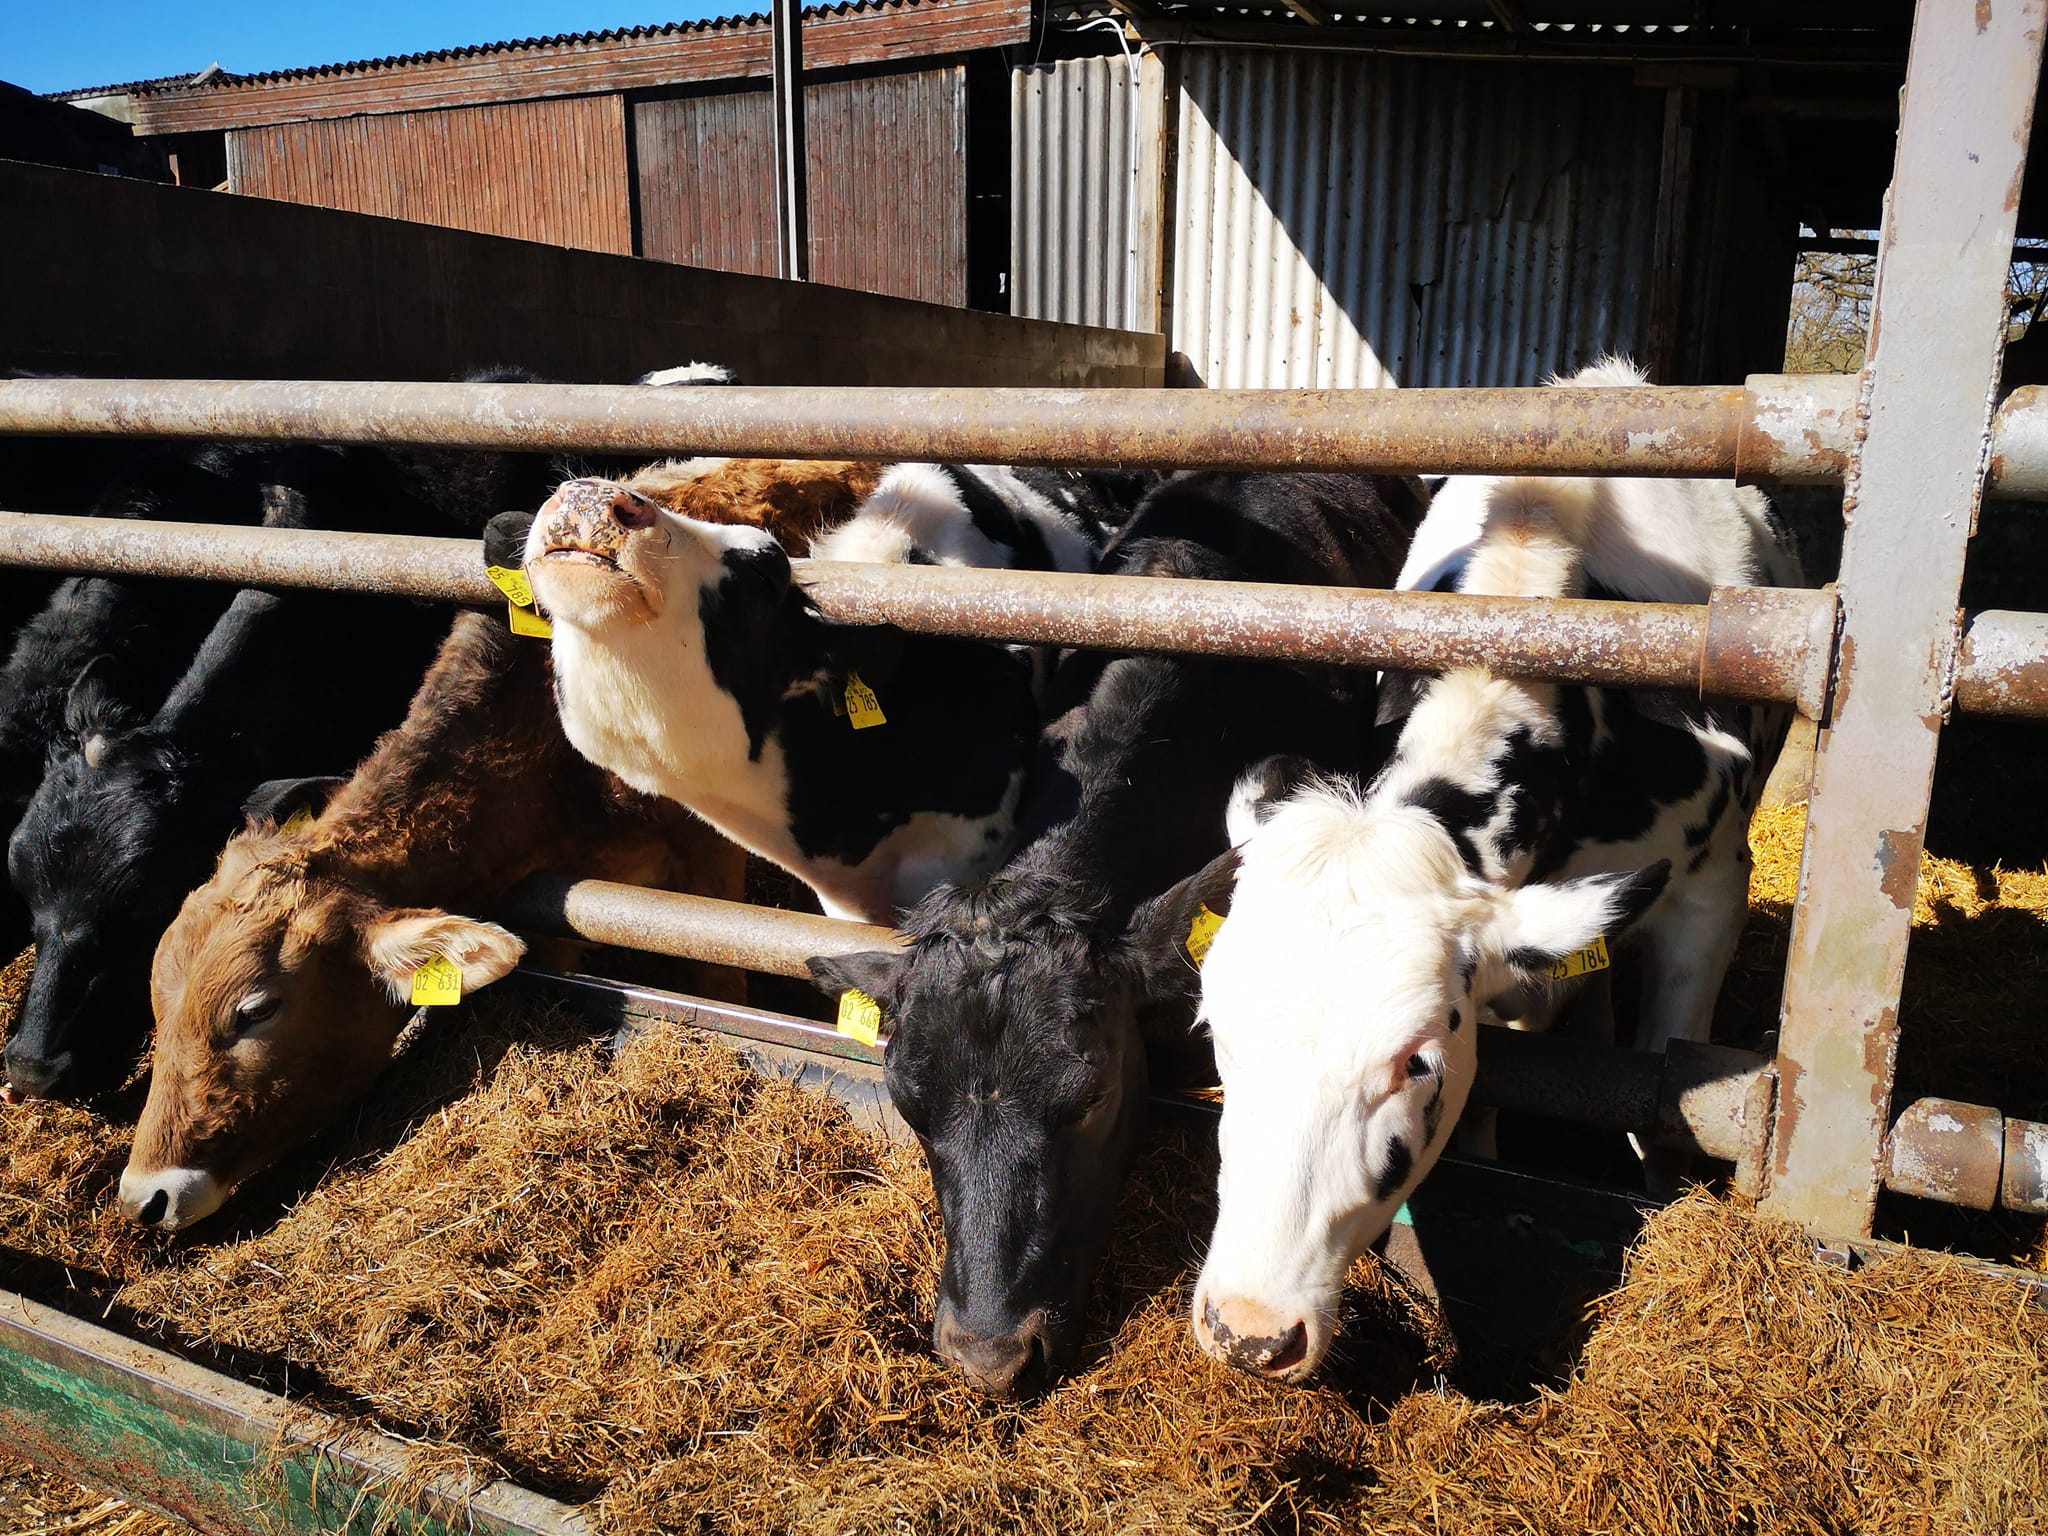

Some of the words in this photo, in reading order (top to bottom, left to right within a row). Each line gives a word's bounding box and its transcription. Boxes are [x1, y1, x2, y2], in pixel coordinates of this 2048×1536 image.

[487, 567, 505, 580] 25
[506, 584, 530, 604] 785
[847, 695, 858, 714] 25
[859, 693, 878, 712] 785
[1576, 946, 1607, 971] 784
[415, 973, 429, 991] 02
[437, 973, 460, 991] 631
[841, 1000, 854, 1020] 02
